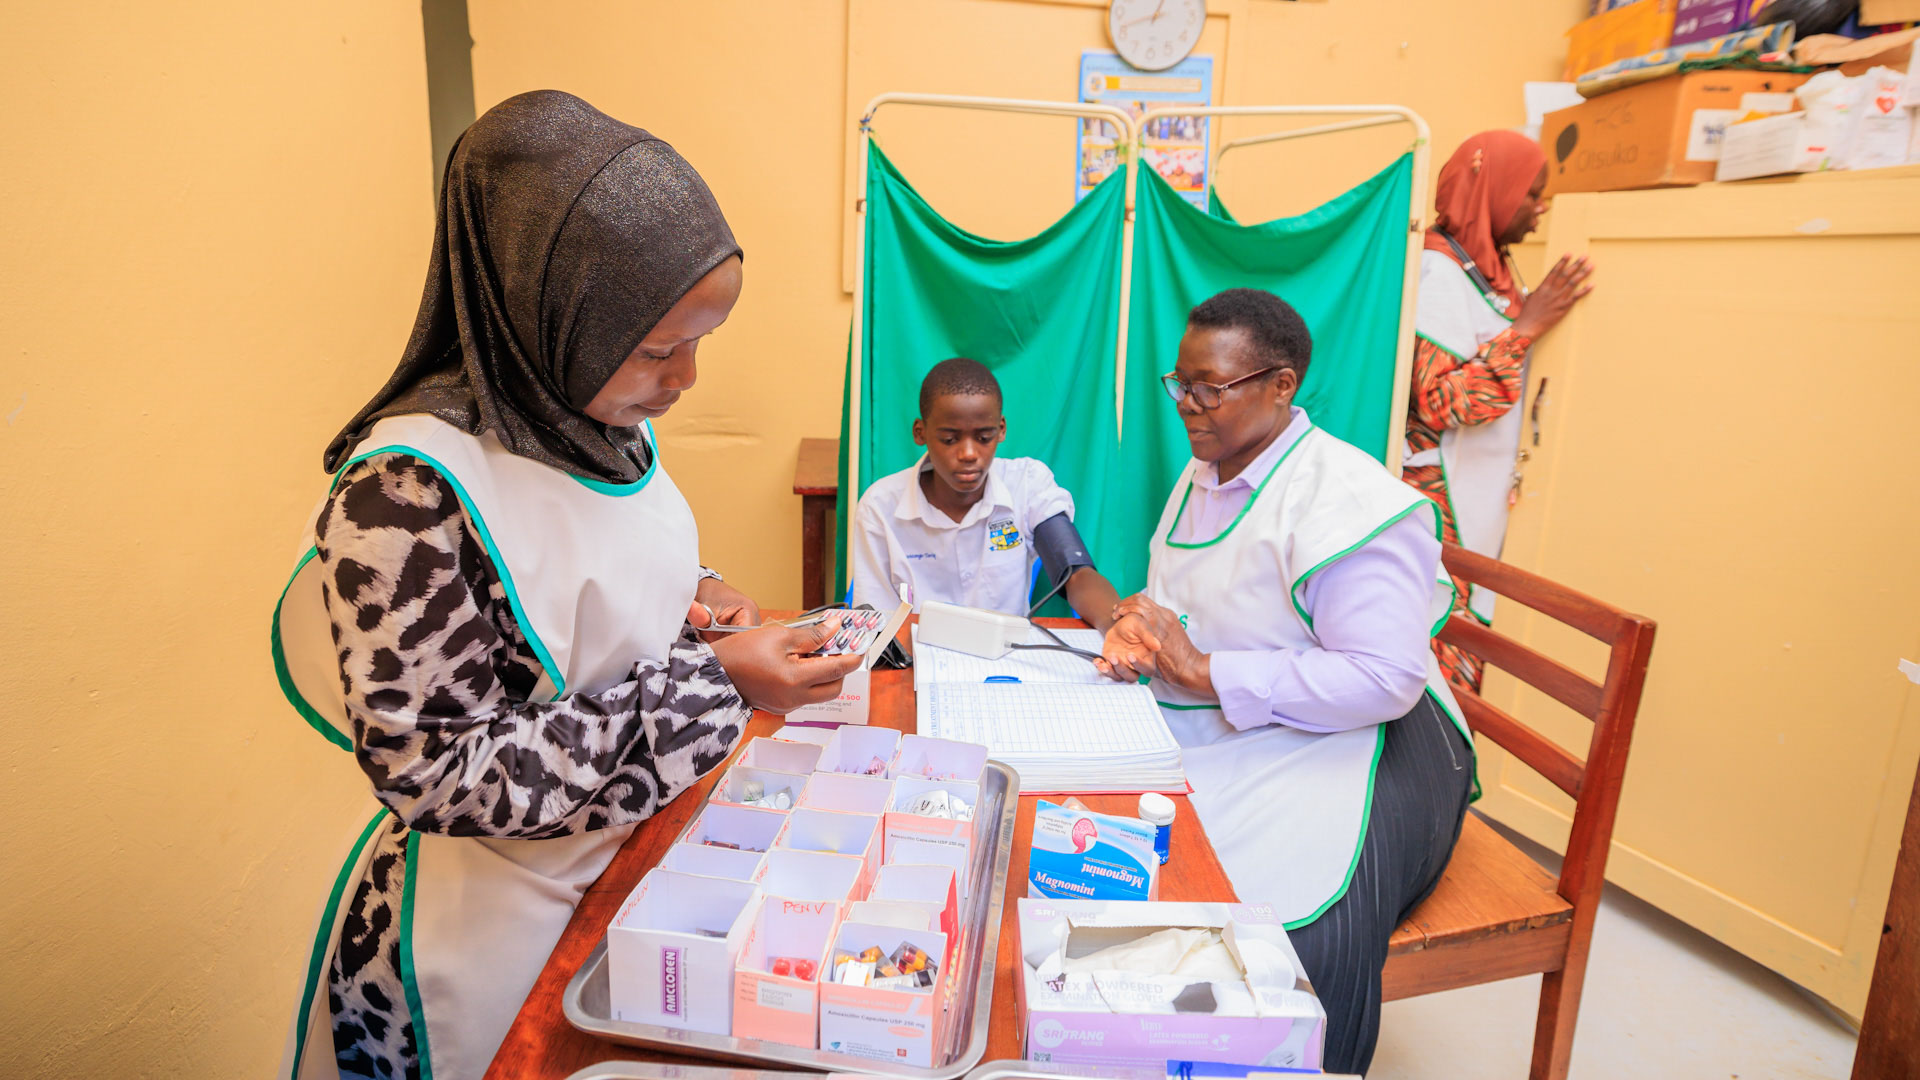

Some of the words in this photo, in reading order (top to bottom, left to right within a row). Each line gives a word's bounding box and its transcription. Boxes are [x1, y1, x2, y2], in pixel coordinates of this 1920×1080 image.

[1131, 40, 1140, 53] 7
[1163, 41, 1173, 56] 5
[1081, 863, 1145, 889] Magnomint
[1034, 871, 1096, 896] Magnomint
[814, 902, 826, 914] V
[665, 952, 677, 1012] AMCLOREN
[861, 1014, 888, 1023] Capsules
[1042, 1028, 1105, 1041] SRITRANG
